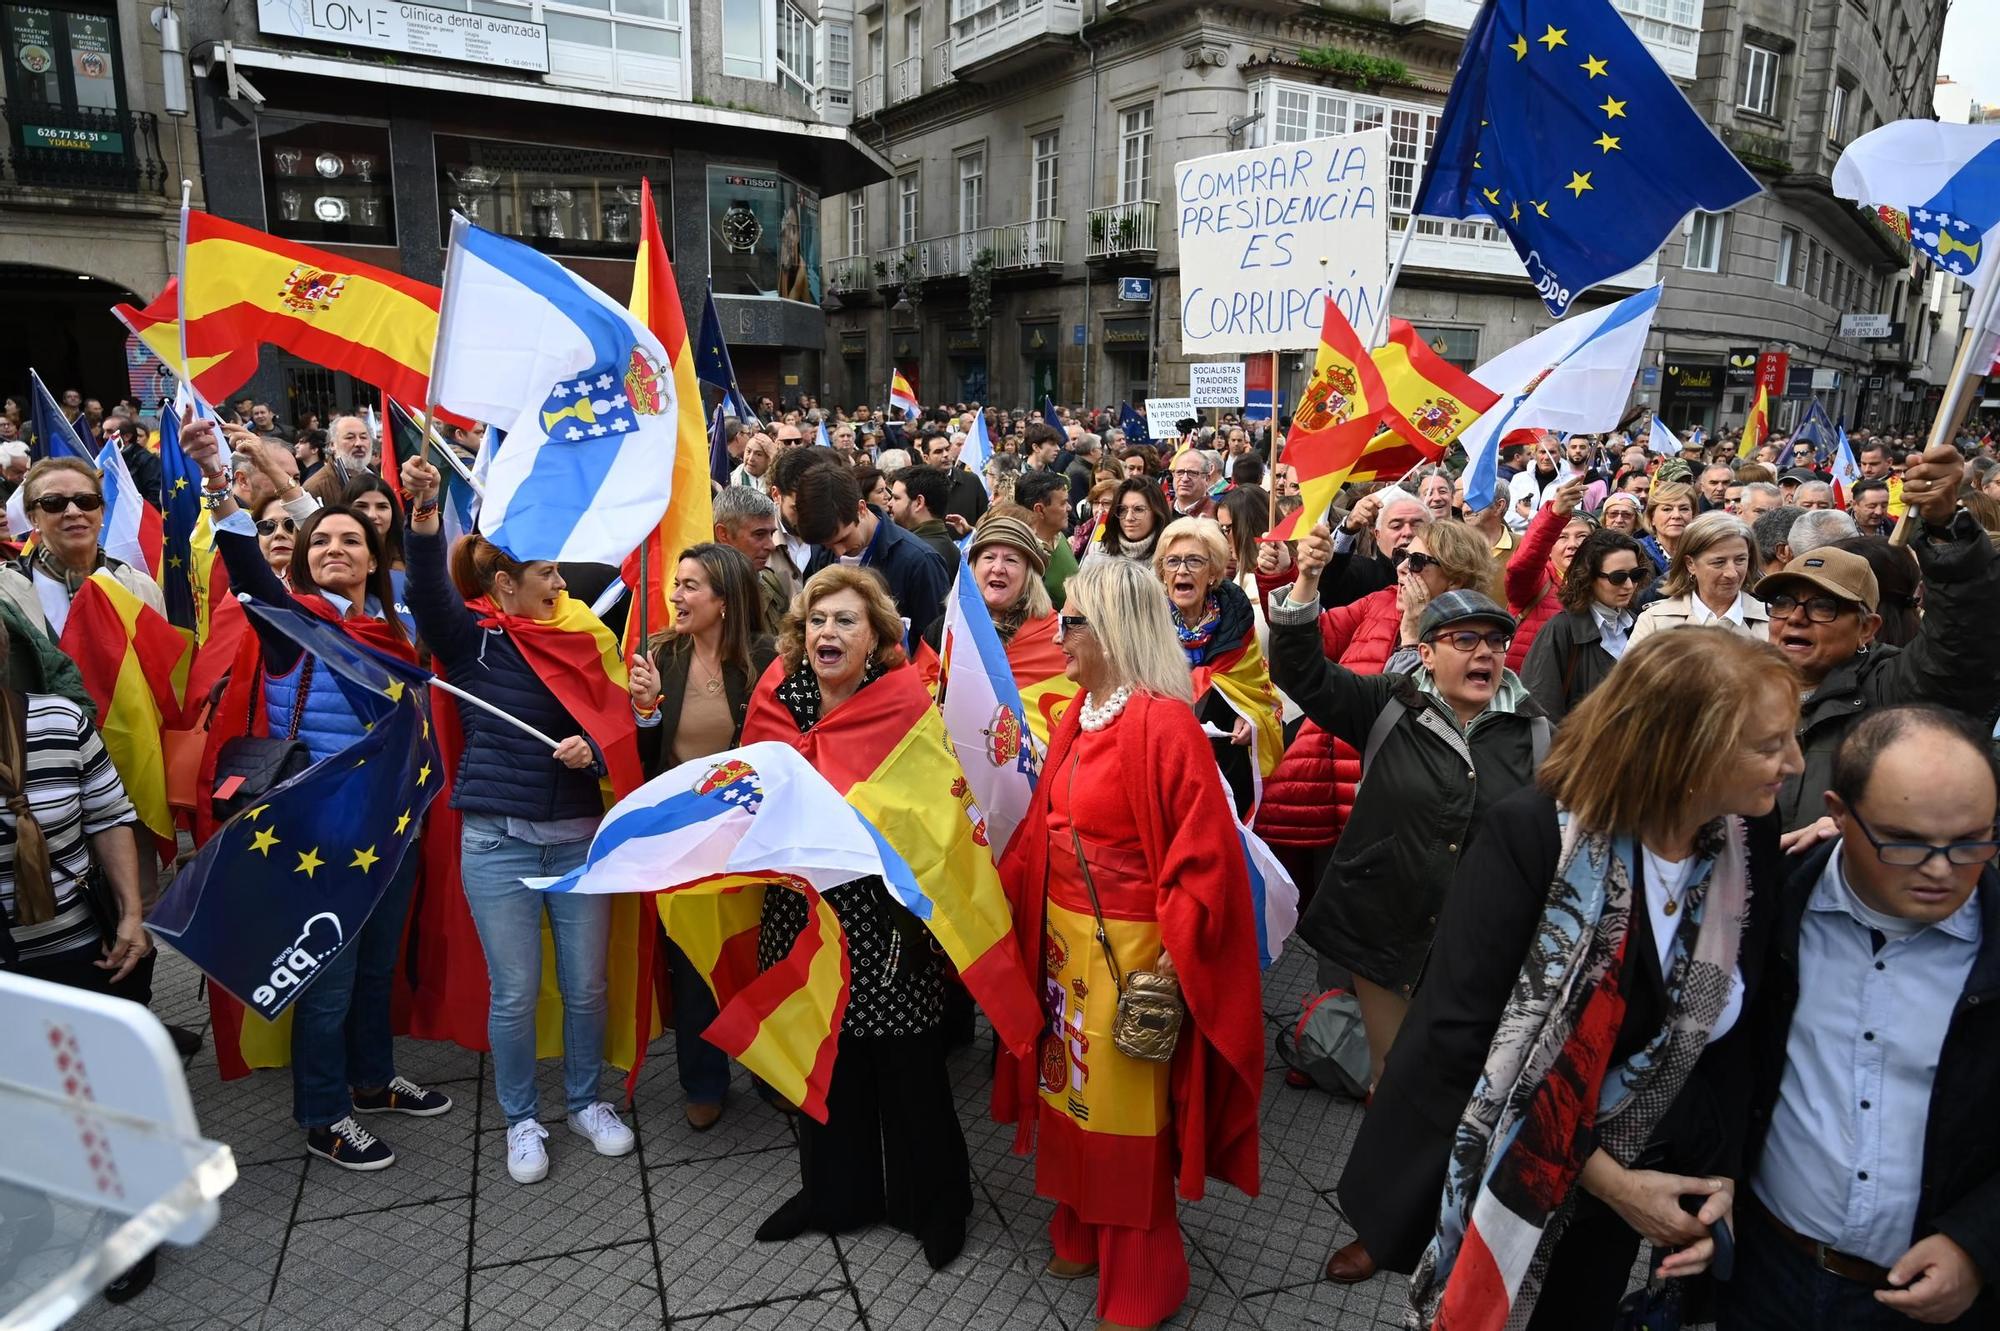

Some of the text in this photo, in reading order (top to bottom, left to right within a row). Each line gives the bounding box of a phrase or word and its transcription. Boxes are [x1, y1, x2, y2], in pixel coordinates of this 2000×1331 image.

[400, 5, 443, 24] Clínica
[447, 14, 483, 30] dental
[487, 21, 541, 39] avanzada
[37, 128, 99, 142] 626 77 36 31
[1180, 146, 1366, 203] COMPRAR LA
[1240, 233, 1295, 270] ES
[1193, 366, 1240, 374] SOCIALISTAS
[1196, 376, 1238, 384] TRAIDORES
[1196, 386, 1238, 395] QUEREMOS
[1193, 396, 1240, 405] ELECCIONES
